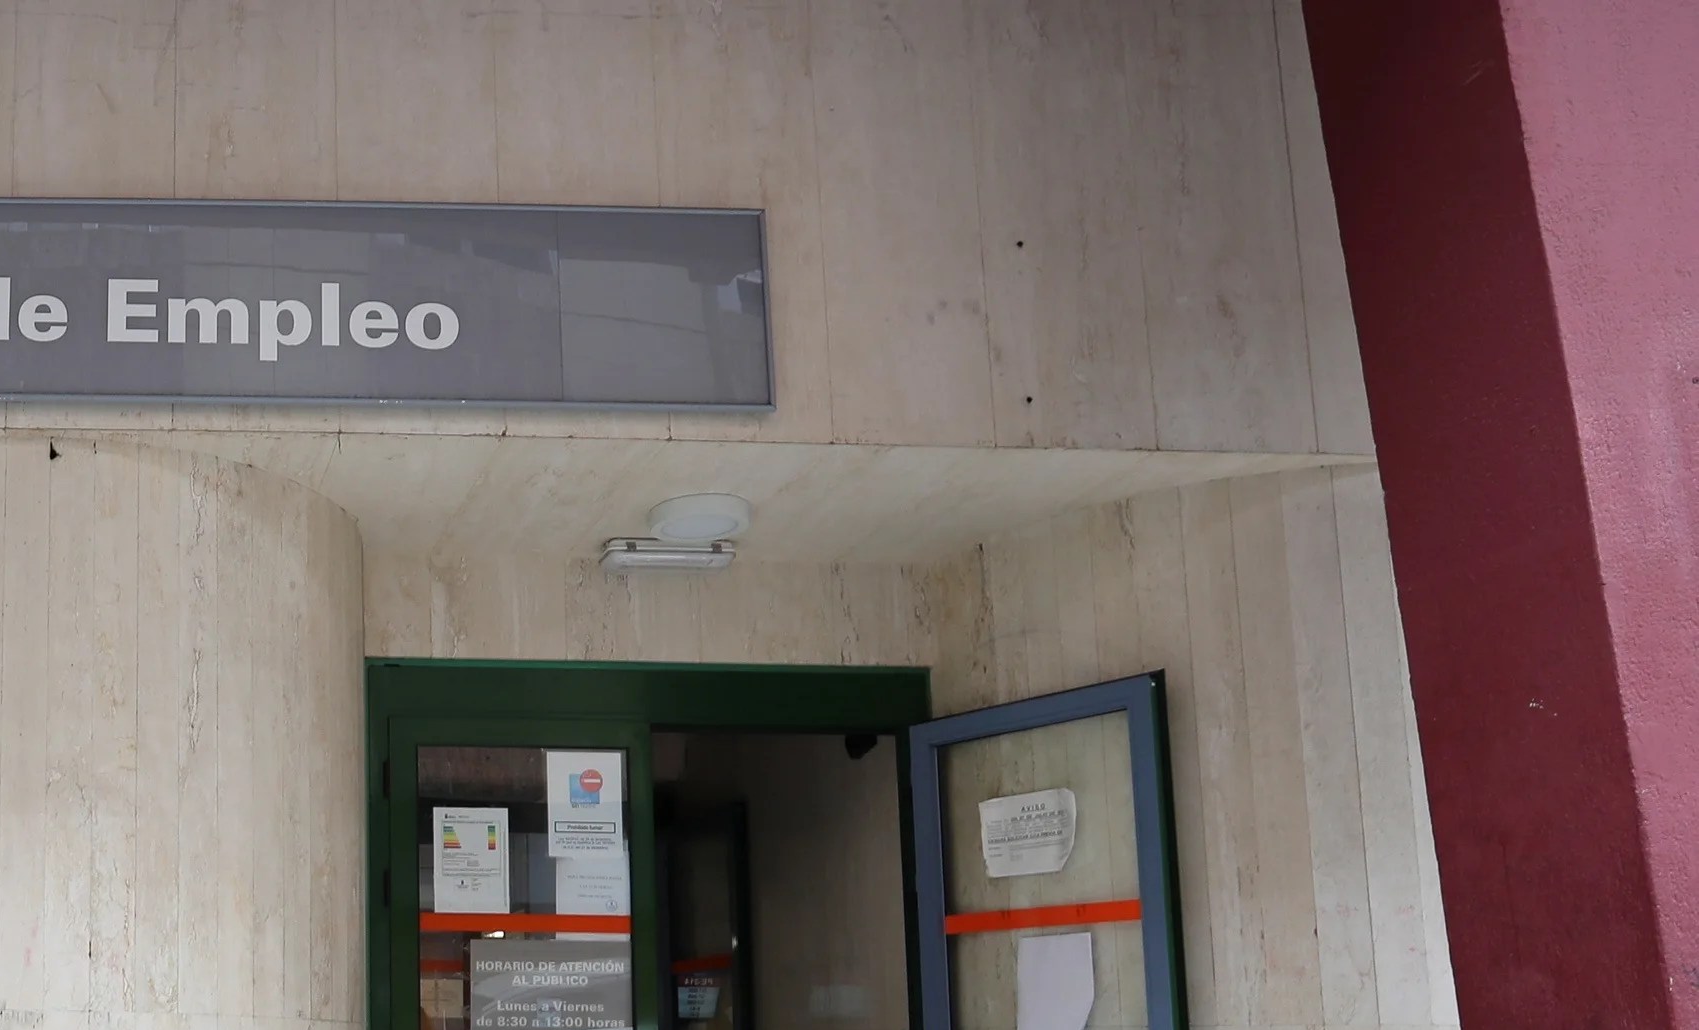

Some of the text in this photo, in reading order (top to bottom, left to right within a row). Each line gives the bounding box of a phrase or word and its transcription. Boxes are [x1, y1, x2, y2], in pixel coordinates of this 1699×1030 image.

[107, 279, 460, 361] Empleo
[476, 960, 624, 973] HORARIO DE ATENCIÓN
[512, 973, 588, 986] AL PÚBLICO
[497, 1000, 604, 1012] Lunes a Viernes
[476, 1015, 625, 1028] de 8:30 a 13:00 horas
